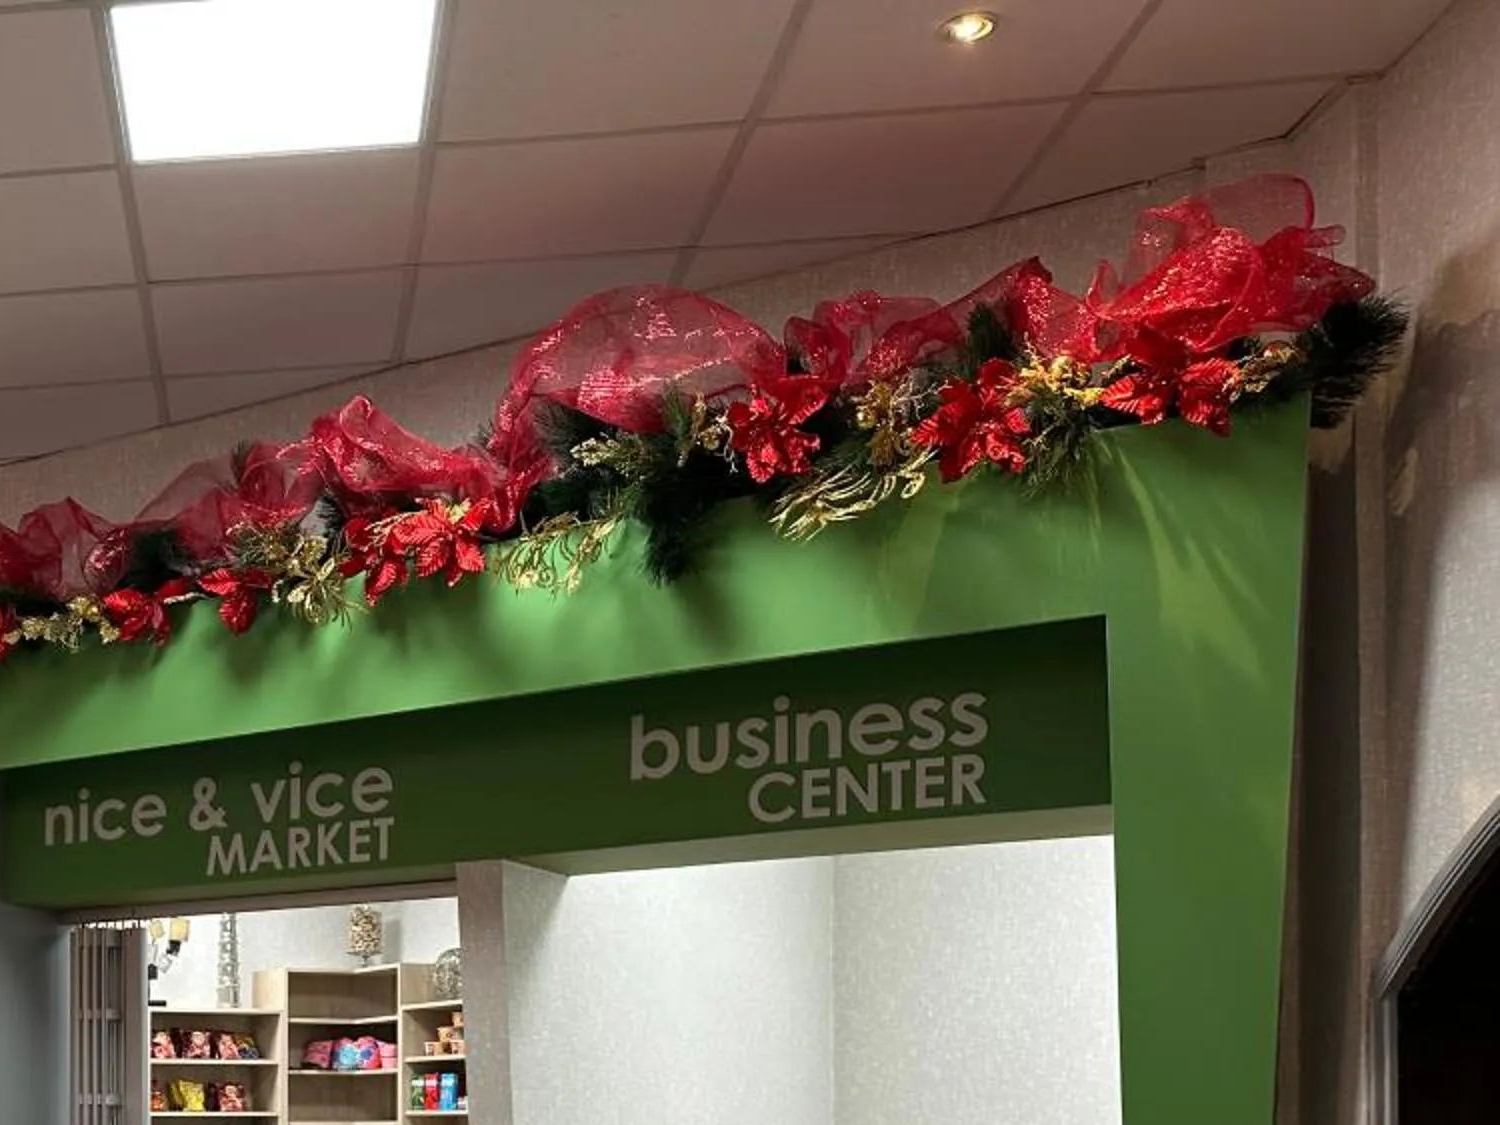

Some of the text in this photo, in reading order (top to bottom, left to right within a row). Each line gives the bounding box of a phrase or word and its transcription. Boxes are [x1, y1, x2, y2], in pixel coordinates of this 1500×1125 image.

[630, 692, 989, 781] business
[44, 761, 394, 846] nice & vice
[748, 753, 987, 823] CENTER
[206, 817, 395, 876] MARKET
